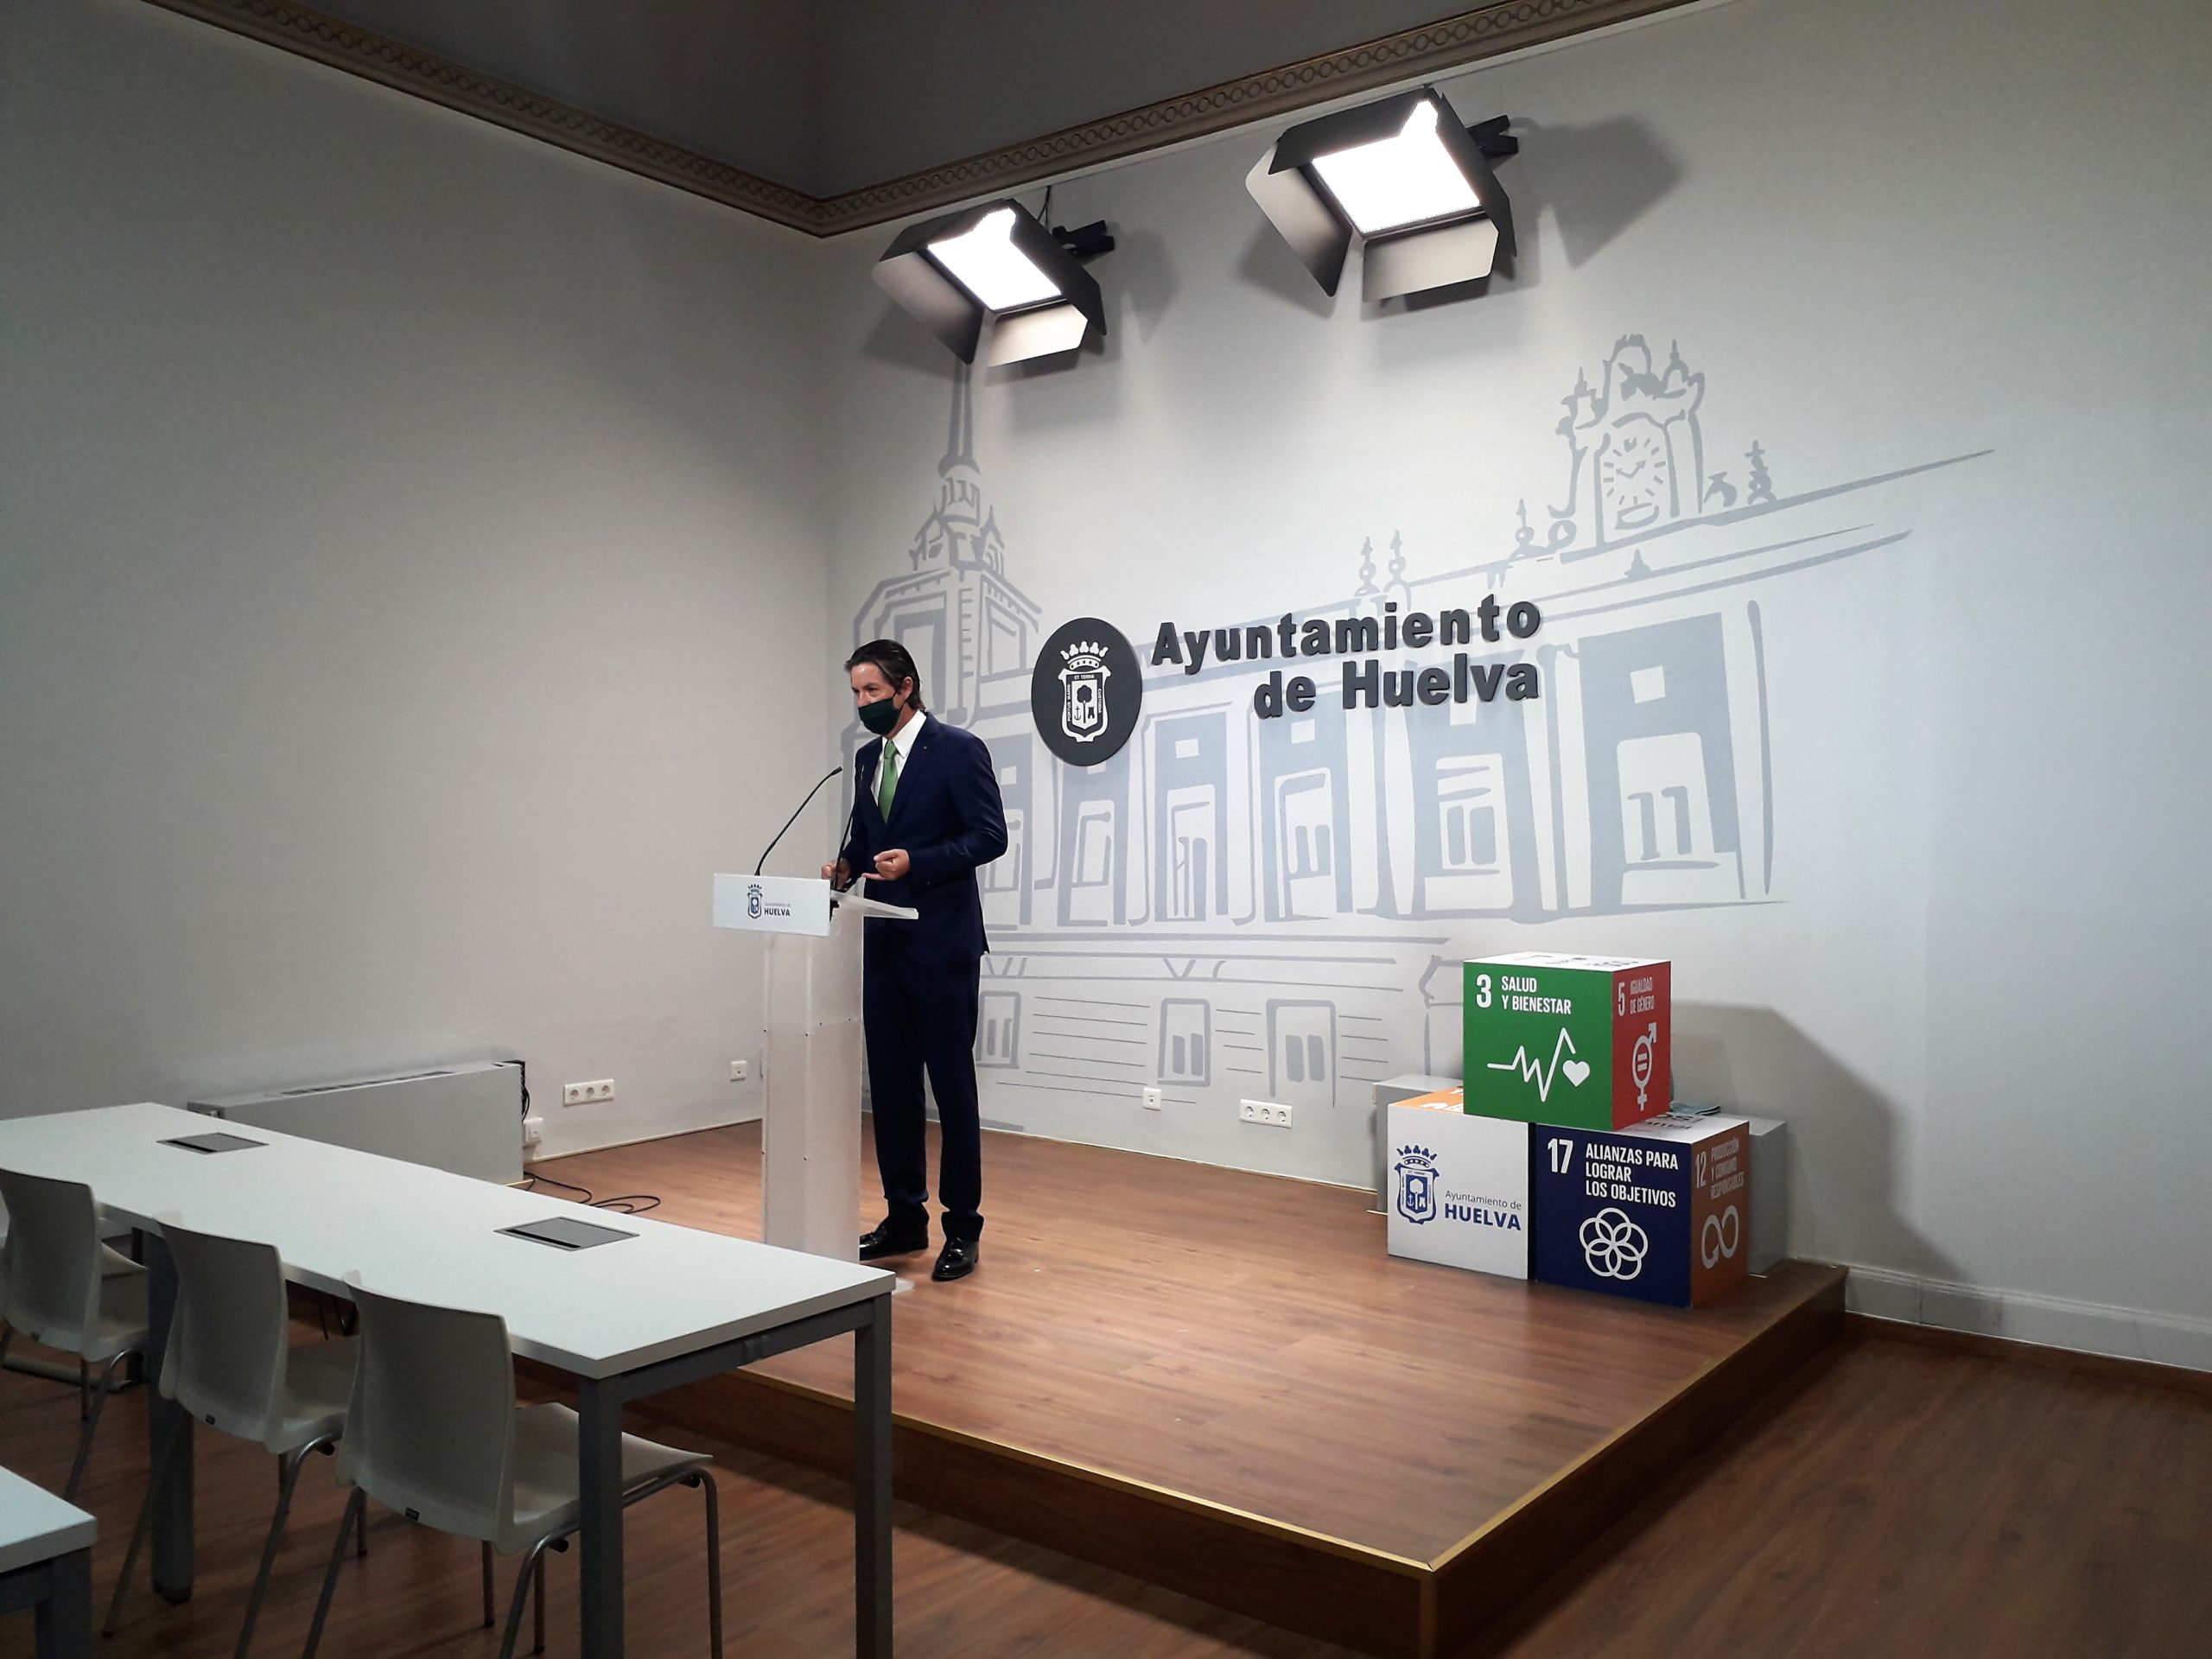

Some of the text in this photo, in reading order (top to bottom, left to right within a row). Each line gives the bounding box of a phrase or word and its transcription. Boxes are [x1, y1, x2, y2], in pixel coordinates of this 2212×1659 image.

[1152, 594, 1541, 676] Ayuntamiento
[1254, 653, 1539, 719] de Huelva
[764, 907, 791, 916] HUELVA
[1476, 974, 1492, 1008] 3
[1501, 976, 1537, 993] SALUD
[1502, 995, 1572, 1015] Y BIENESTAR
[1618, 982, 1625, 1016] 5
[1548, 1138, 1573, 1174] 17
[1586, 1143, 1679, 1170] ALIANZAS PARA
[1695, 1151, 1707, 1188] 12
[1586, 1161, 1631, 1182] LOGRAR
[1445, 1190, 1508, 1208] Ayuntamiento
[1510, 1200, 1522, 1210] de
[1586, 1180, 1676, 1207] LOS OBJETIVOS
[1445, 1204, 1521, 1230] HUELVA
